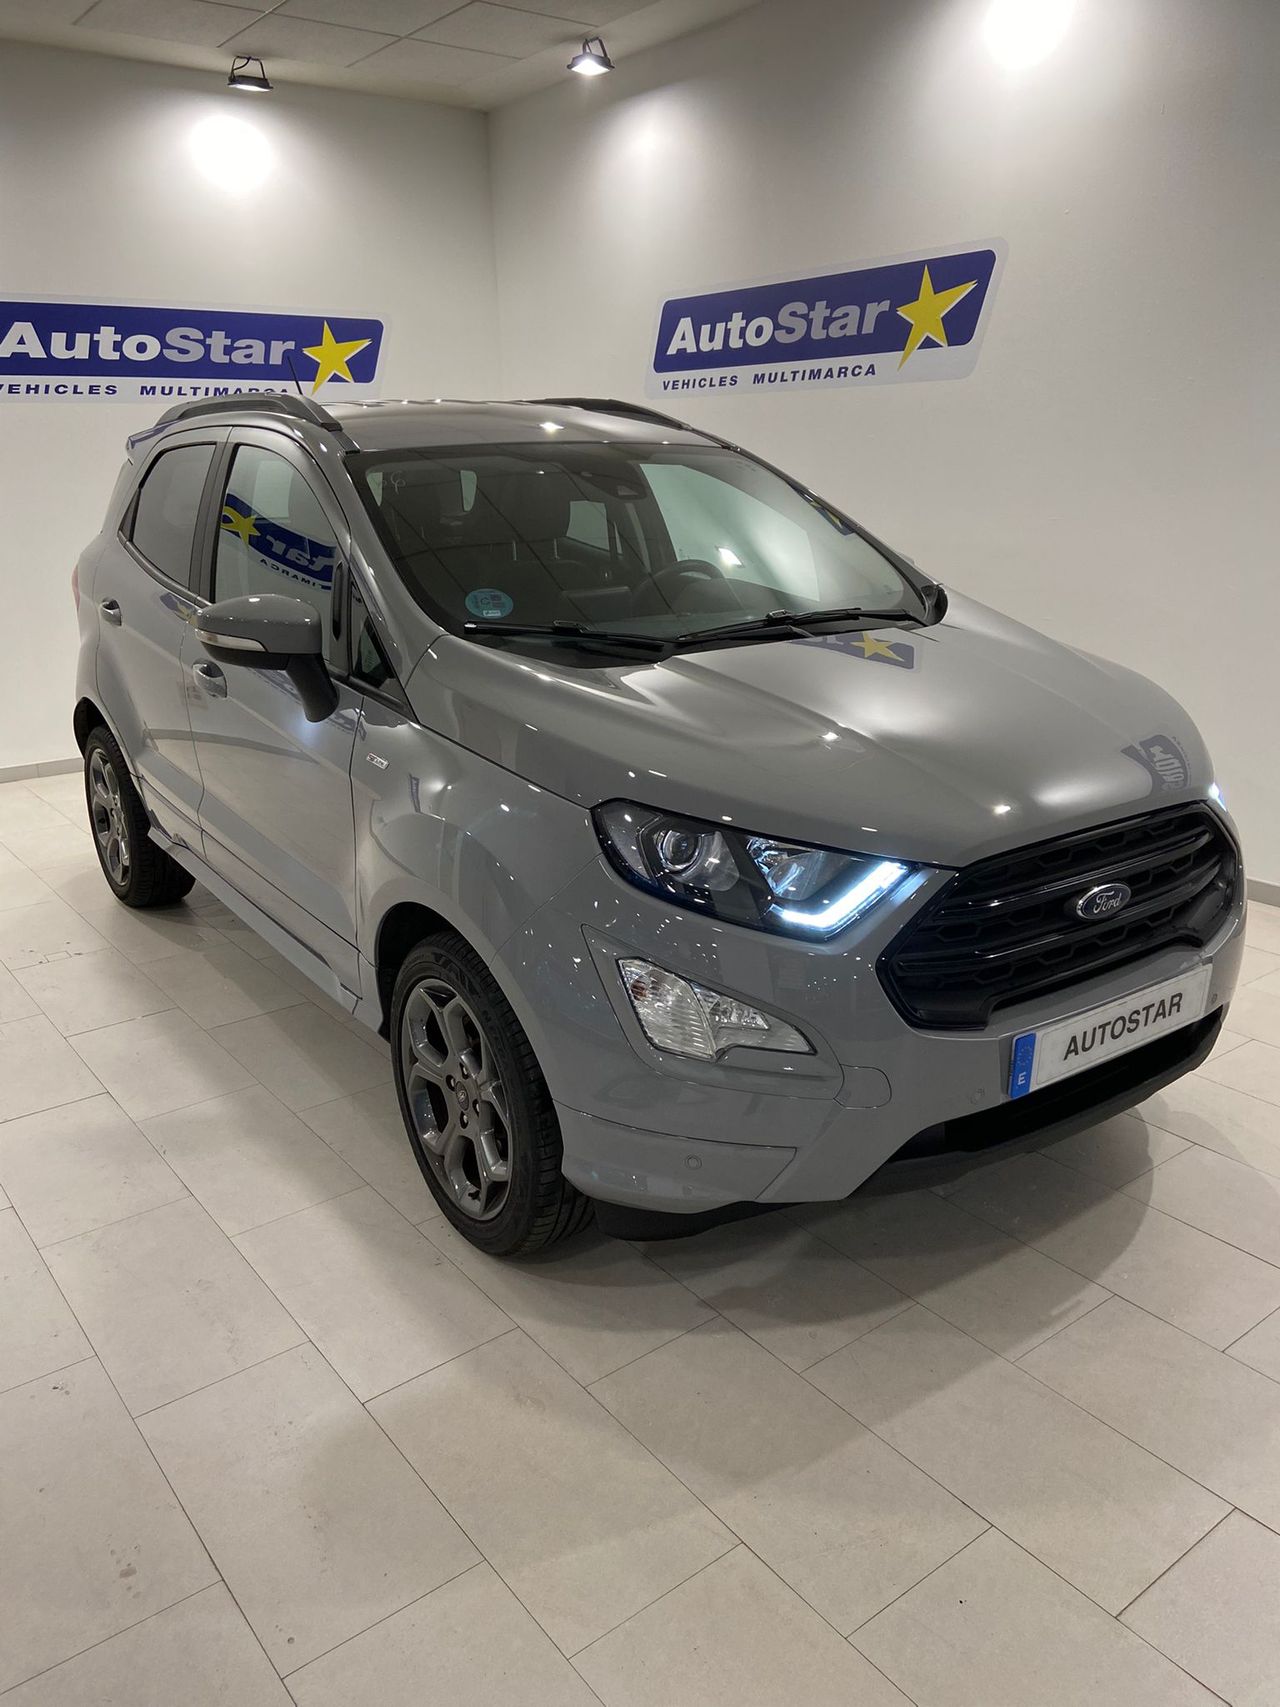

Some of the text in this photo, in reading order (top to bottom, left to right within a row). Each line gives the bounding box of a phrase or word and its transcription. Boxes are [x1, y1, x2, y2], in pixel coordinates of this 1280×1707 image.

[0, 322, 296, 365] AutoStar
[666, 300, 890, 355] AutoStar
[662, 363, 877, 390] VEHICLES MULTIMARCA
[1093, 890, 1122, 913] Ford
[1063, 992, 1183, 1060] AUTOSTAR
[1017, 1071, 1027, 1086] E
